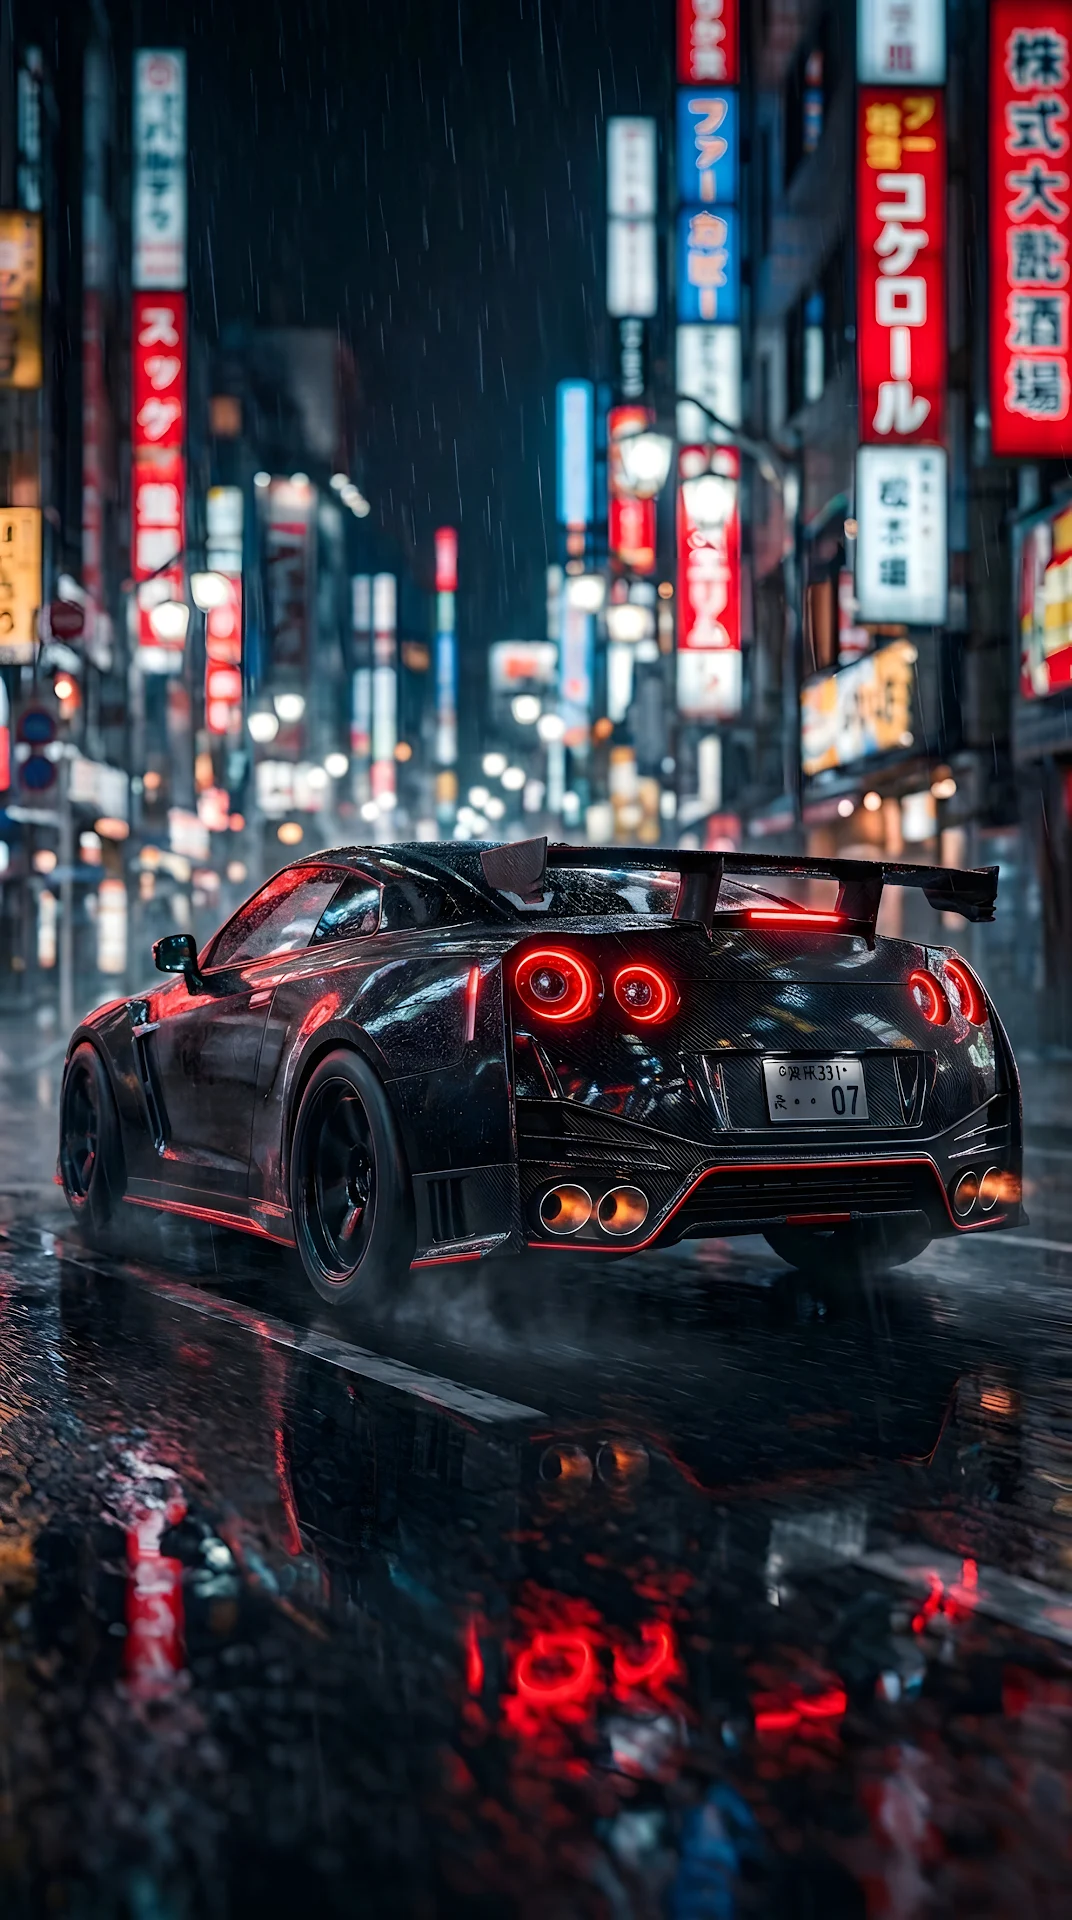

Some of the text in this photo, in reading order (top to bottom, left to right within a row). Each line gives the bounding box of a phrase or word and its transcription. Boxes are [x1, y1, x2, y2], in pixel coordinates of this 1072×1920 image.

[874, 173, 930, 435] コケロール
[831, 1085, 859, 1115] 07
